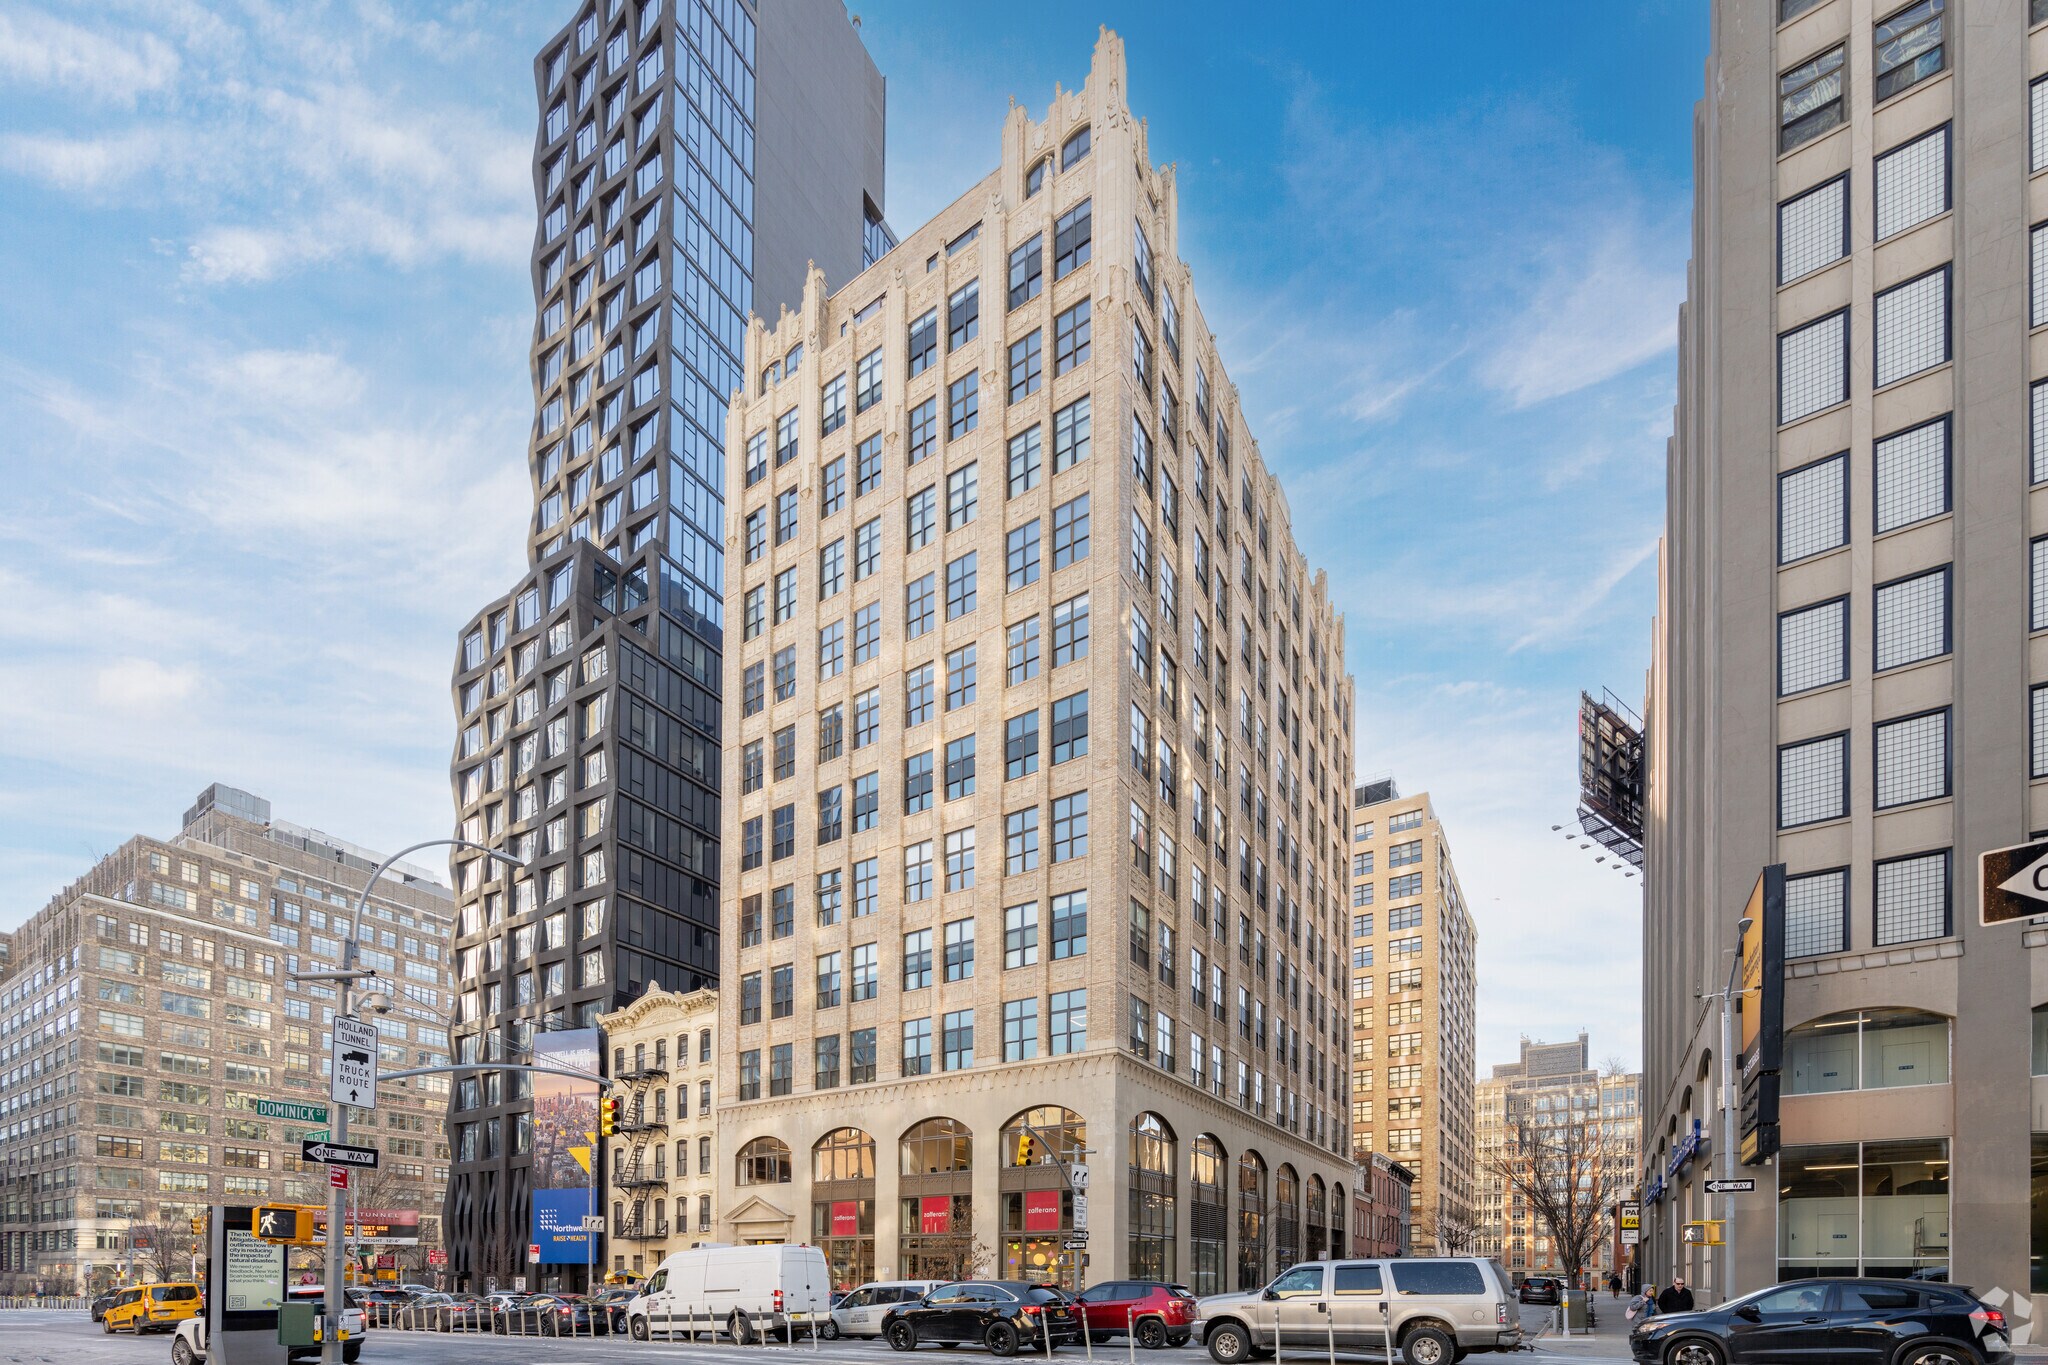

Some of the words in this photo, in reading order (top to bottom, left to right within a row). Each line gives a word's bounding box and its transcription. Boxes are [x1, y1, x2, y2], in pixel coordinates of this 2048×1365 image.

[338, 1020, 374, 1037] HOLLAND
[341, 1032, 370, 1047] TUNNEL
[340, 1063, 370, 1078] TRUCK
[339, 1075, 369, 1088] ROUTE
[259, 1101, 315, 1120] DOMINICK
[316, 1108, 326, 1117] ST
[314, 1147, 337, 1158] ONE
[347, 1151, 370, 1162] WAY
[1028, 1206, 1057, 1214] zafferano
[553, 1224, 583, 1232] Northwe
